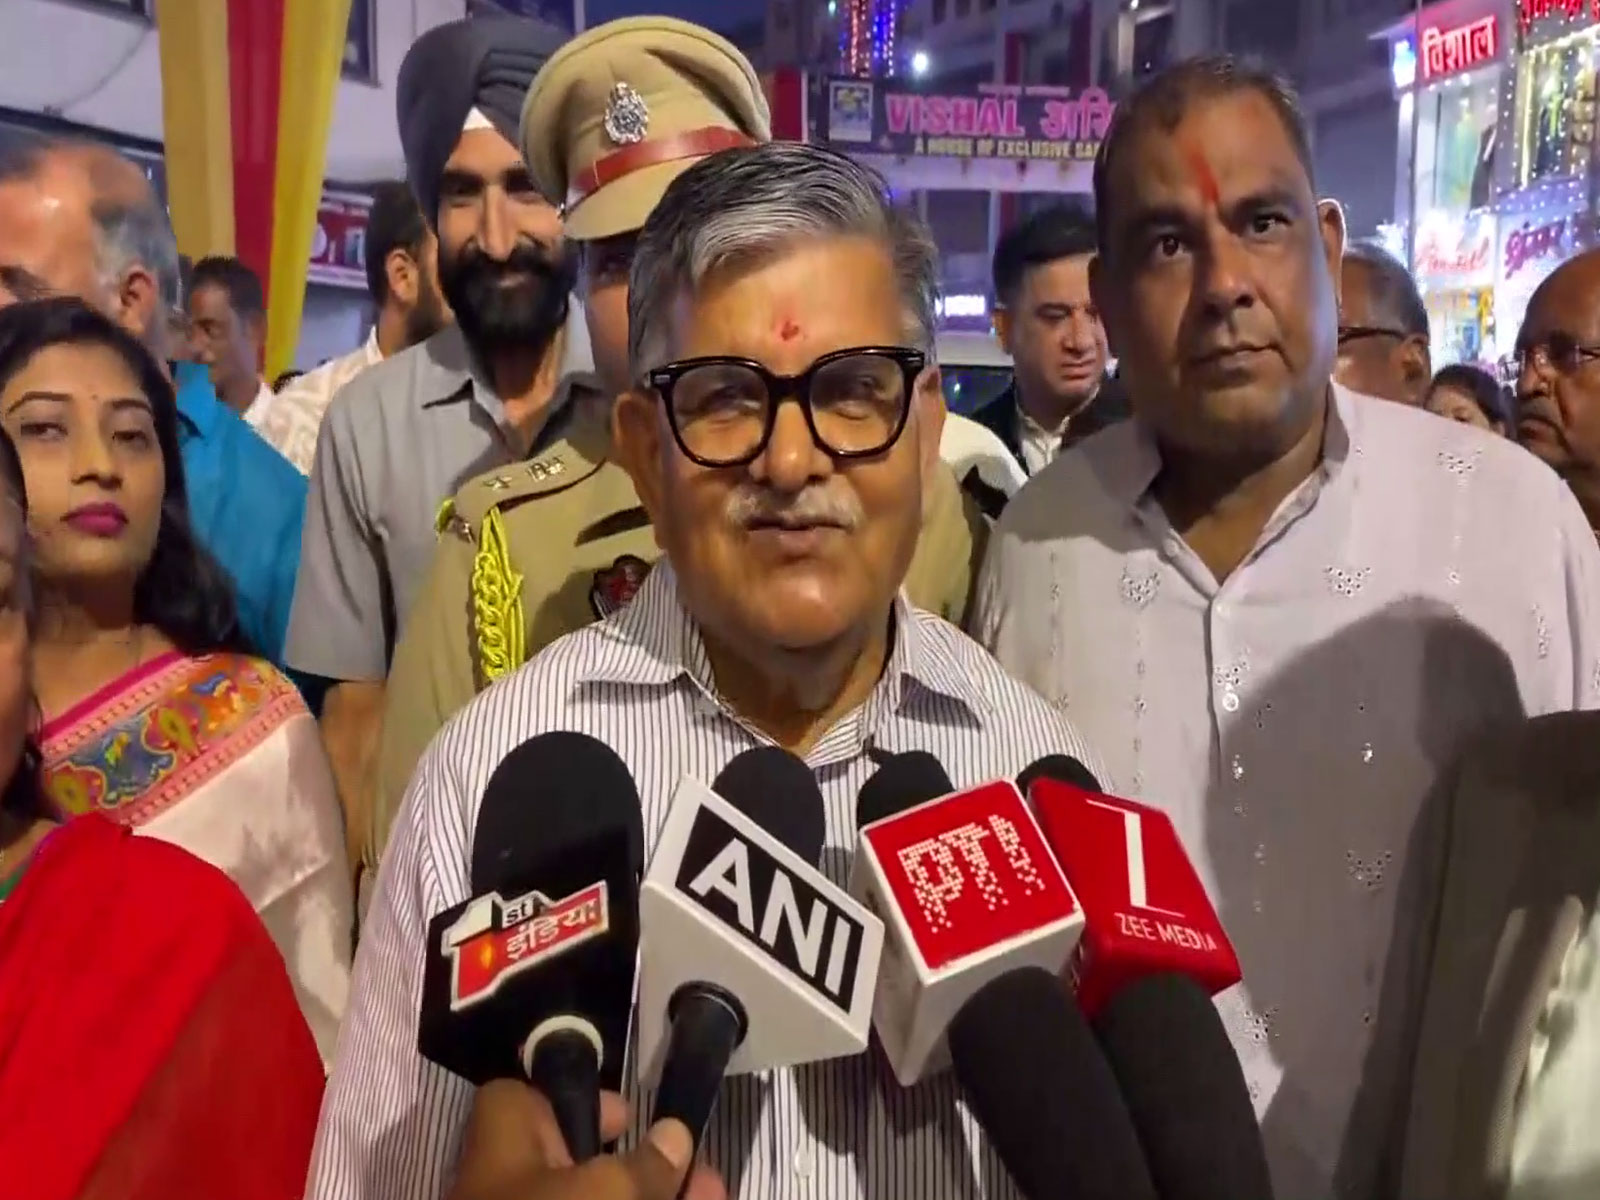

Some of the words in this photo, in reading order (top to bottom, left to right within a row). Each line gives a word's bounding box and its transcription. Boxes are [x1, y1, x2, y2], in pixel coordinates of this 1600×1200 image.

[1422, 14, 1495, 78] विशाल
[885, 93, 1025, 136] VISHAL
[999, 140, 1072, 158] EXCLUSIVE
[506, 897, 599, 960] इंडिया
[690, 838, 852, 997] ANI
[1113, 911, 1157, 940] ZEE
[1155, 921, 1217, 952] MEDIA
